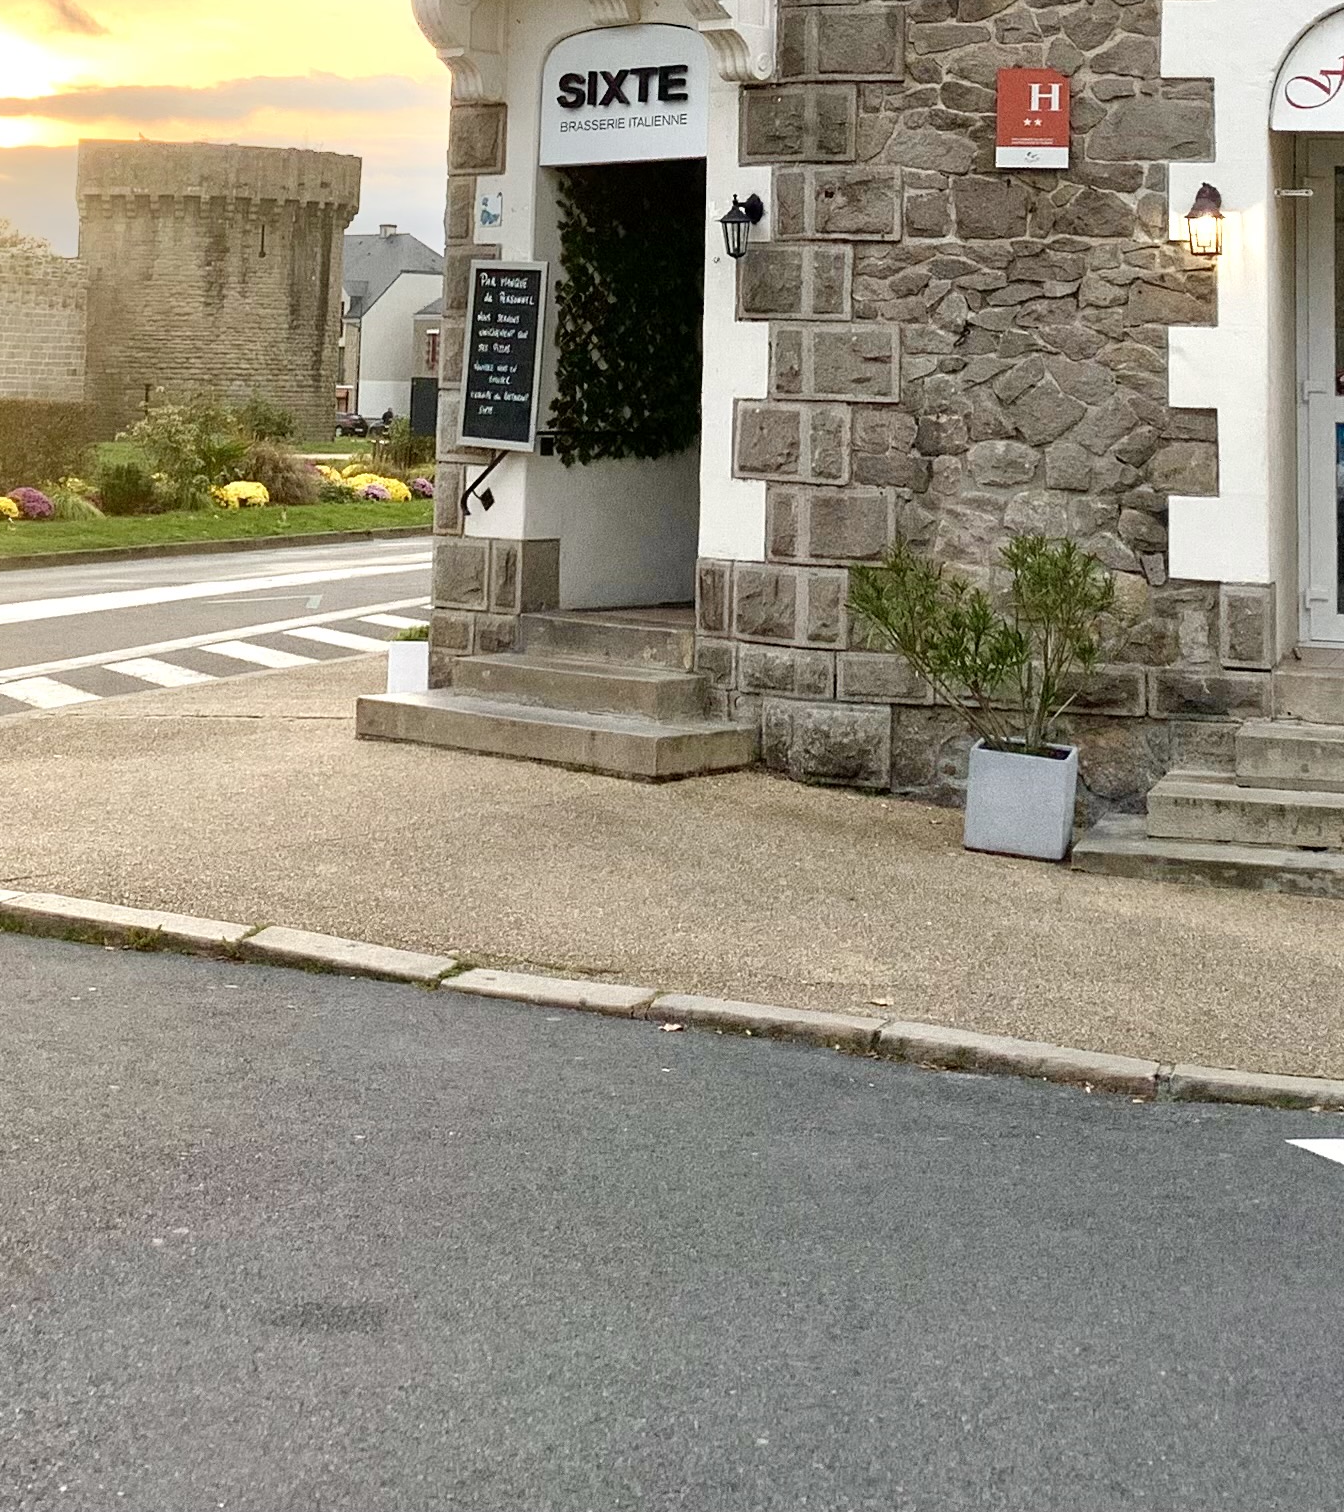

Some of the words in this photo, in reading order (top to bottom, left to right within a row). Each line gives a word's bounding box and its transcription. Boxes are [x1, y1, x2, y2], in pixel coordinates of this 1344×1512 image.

[557, 64, 688, 109] SIXTE
[1028, 83, 1063, 112] H
[560, 118, 625, 133] BRASSERIE
[628, 113, 688, 128] ITALIENNE
